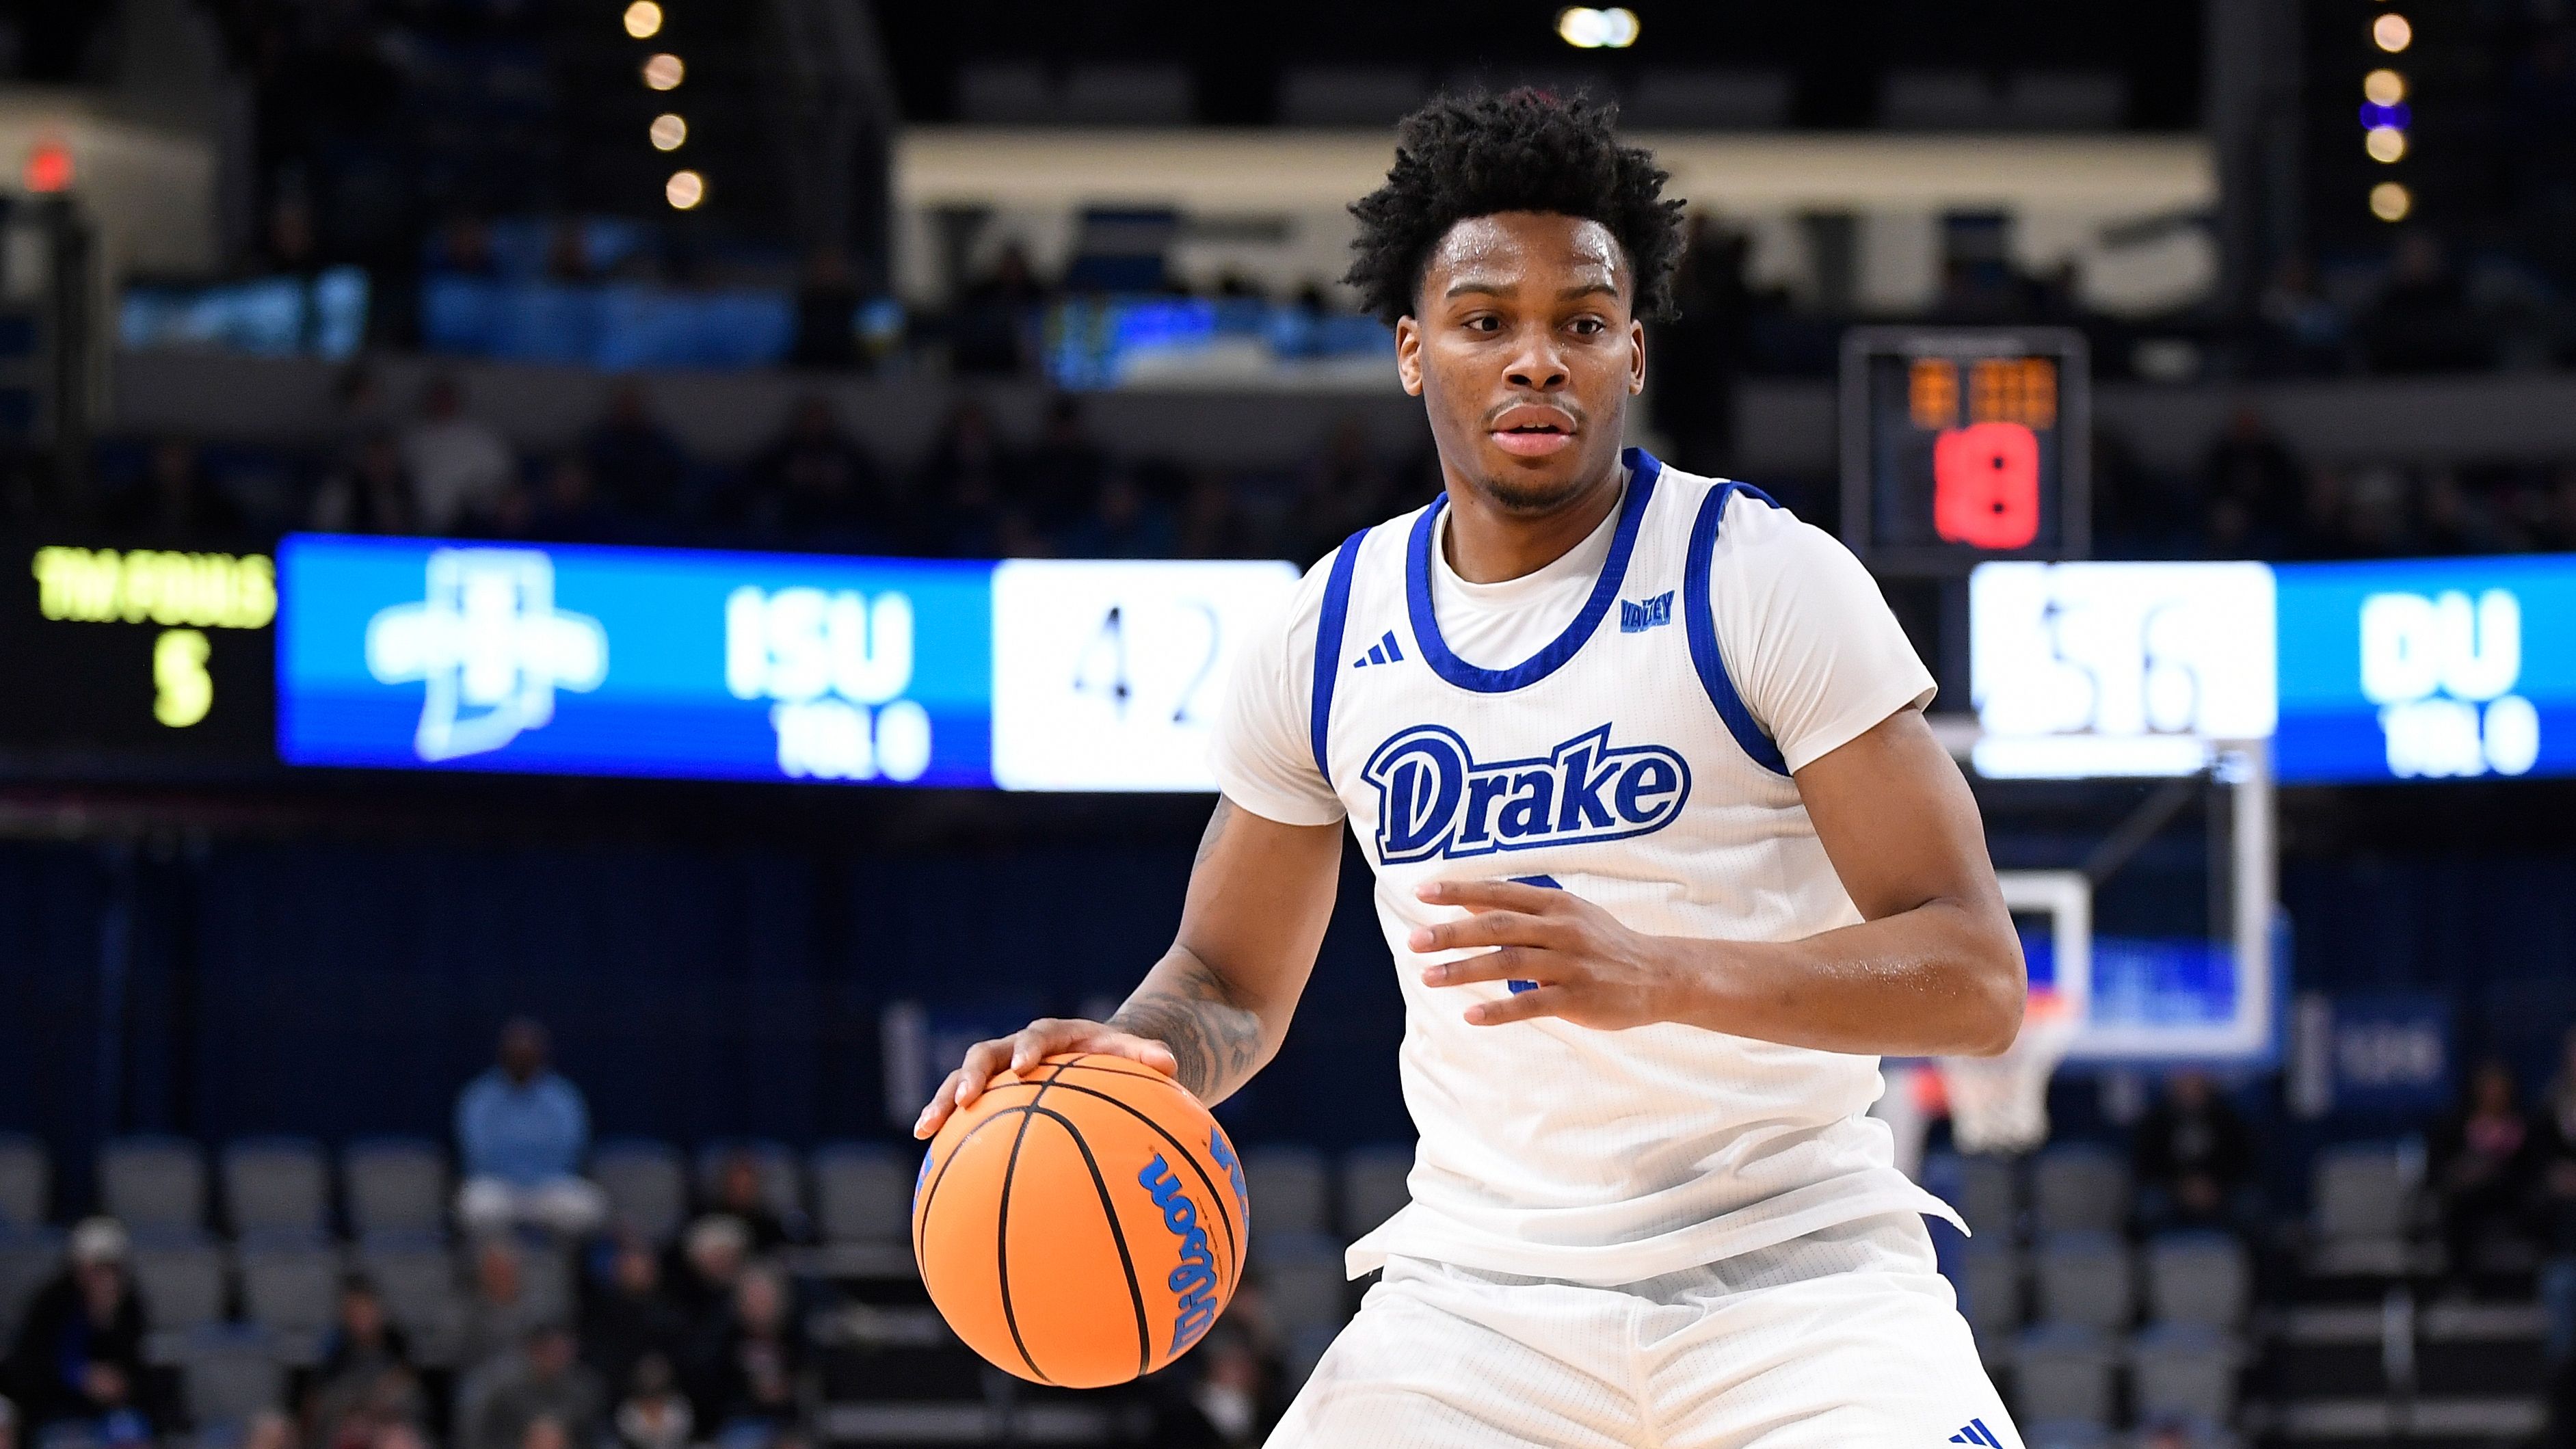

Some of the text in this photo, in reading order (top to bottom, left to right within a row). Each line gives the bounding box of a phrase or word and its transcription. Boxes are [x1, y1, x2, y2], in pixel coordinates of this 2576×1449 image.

[155, 629, 212, 728] 5
[725, 585, 914, 705] ISU
[1070, 594, 1225, 732] 42
[2360, 587, 2521, 704] DU
[1366, 728, 1685, 860] Drake
[1138, 1152, 1217, 1357] Wilson
